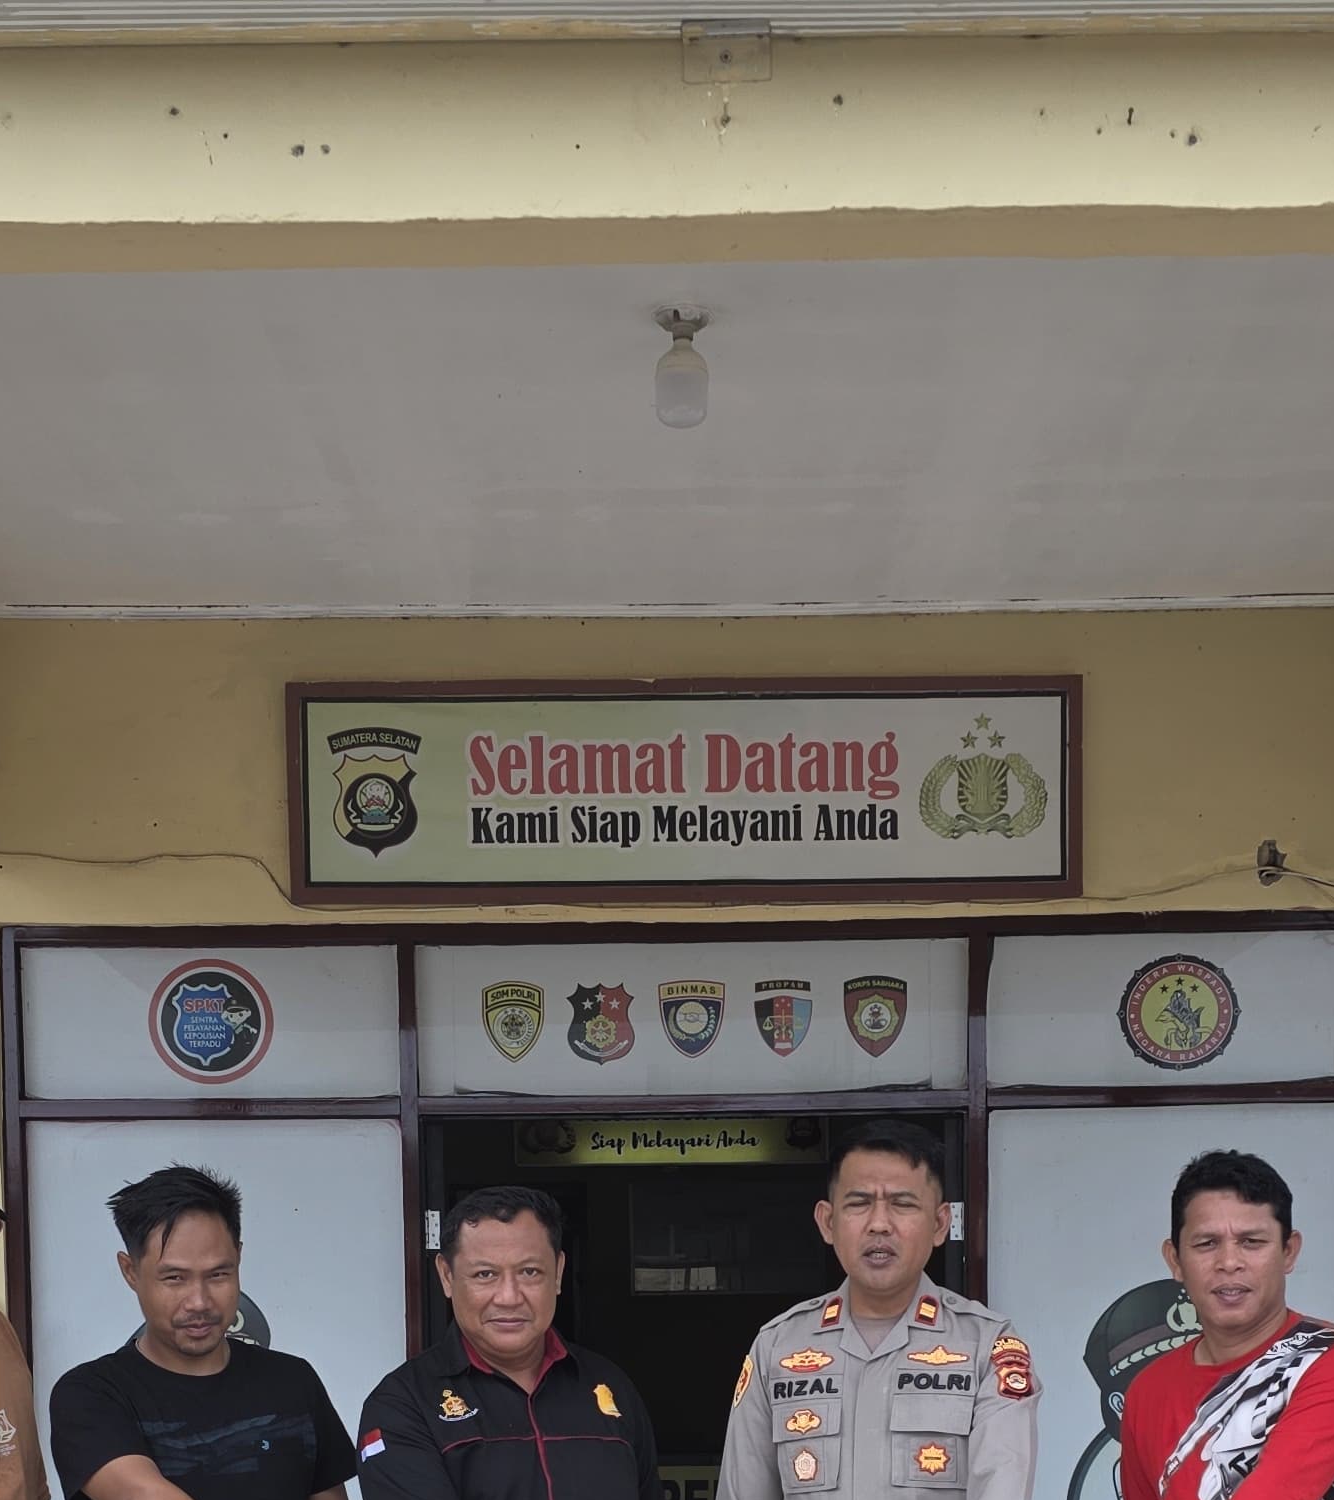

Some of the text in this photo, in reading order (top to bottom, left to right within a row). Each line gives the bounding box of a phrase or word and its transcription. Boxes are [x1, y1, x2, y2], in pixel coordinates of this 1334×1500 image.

[332, 733, 418, 750] SUMATERA SELATAN
[470, 732, 900, 800] Selamat Datang
[471, 803, 900, 848] Kami Siap Melayani Anda
[667, 984, 716, 995] BINMAS
[762, 981, 804, 990] PROPAM
[847, 979, 904, 991] KORPS SABHARA
[1132, 964, 1227, 1006] INDERA WASPADA
[490, 988, 536, 1001] SDM POLRI
[183, 998, 226, 1014] SPKT
[183, 1024, 226, 1032] PELAYANAN
[190, 1016, 218, 1024] SENTRA
[183, 1032, 226, 1040] KEPOLISIAN
[189, 1040, 221, 1048] TERPADU
[1132, 1022, 1227, 1061] NEGARA RAHARJA
[590, 1131, 625, 1155] Siap
[773, 1377, 839, 1399] RIZAL
[897, 1373, 972, 1392] POLRI
